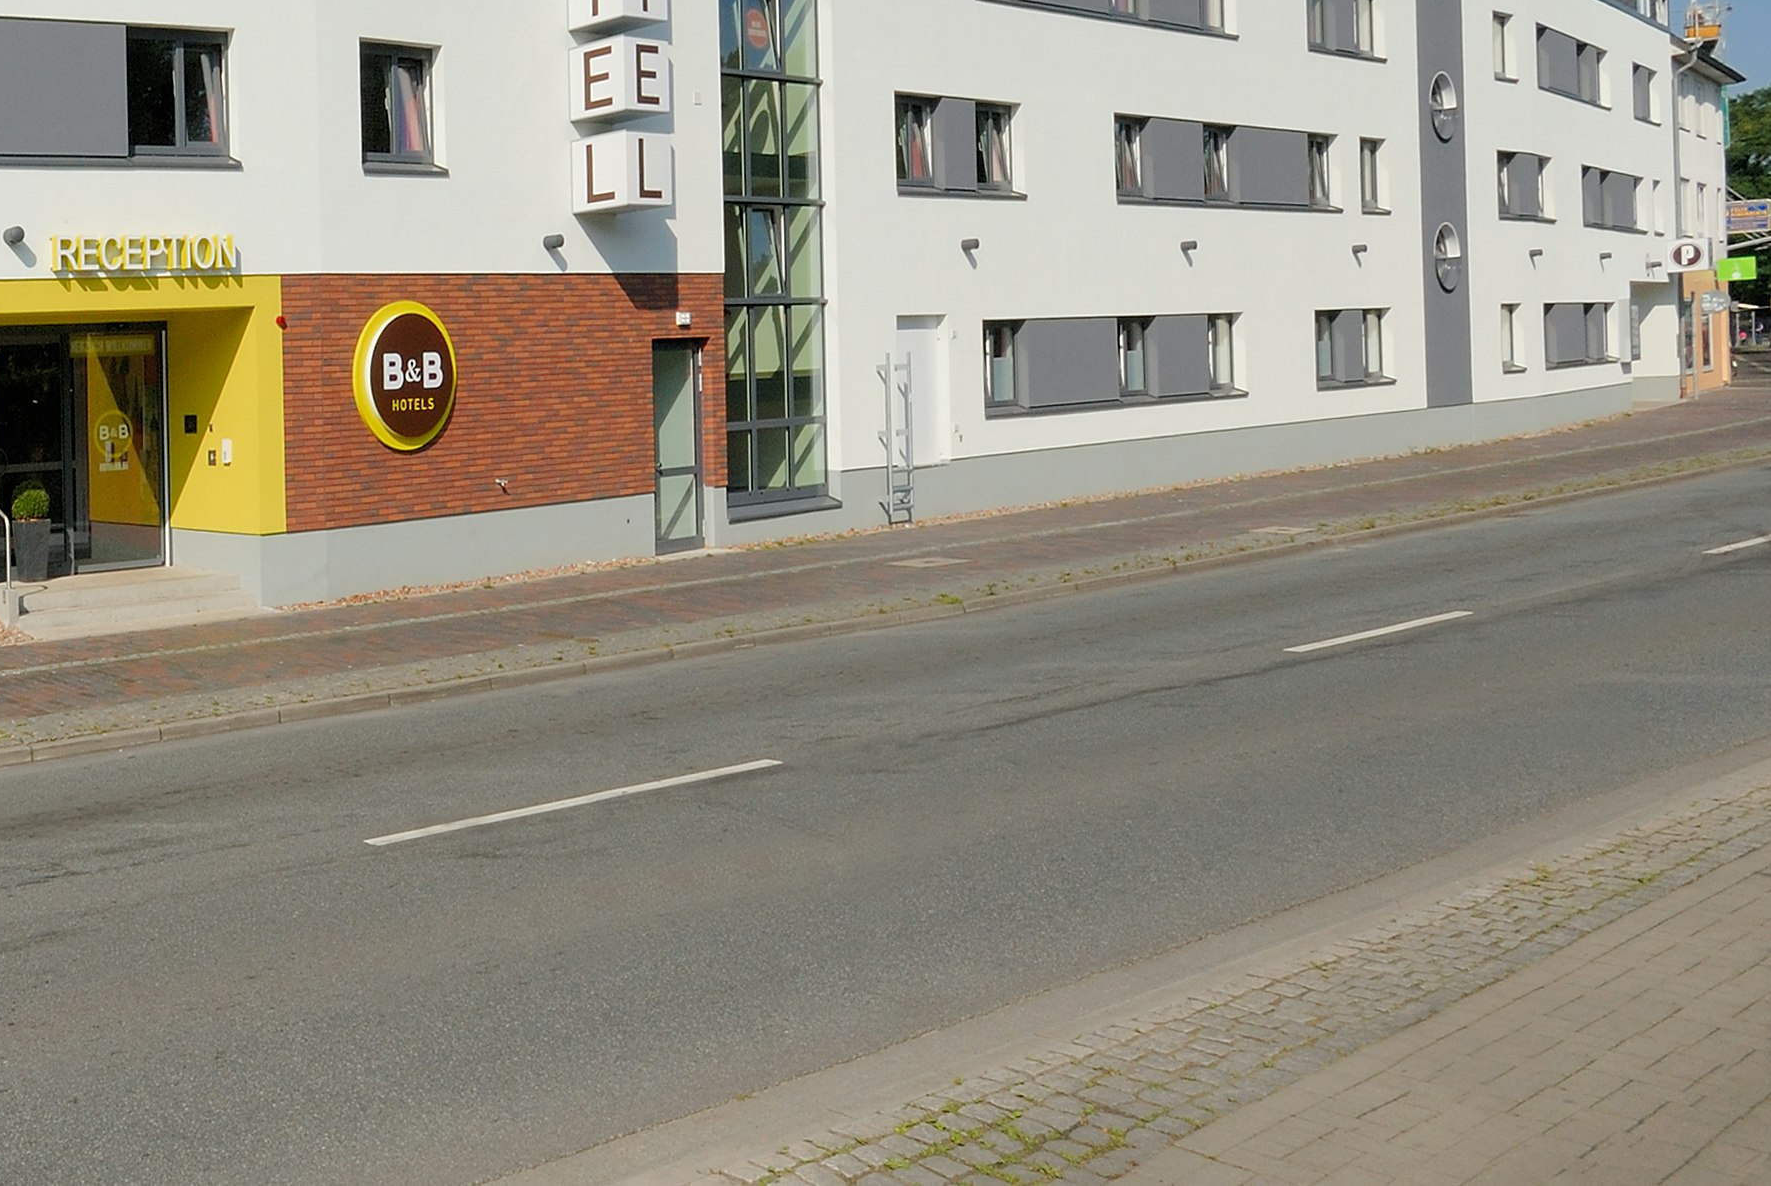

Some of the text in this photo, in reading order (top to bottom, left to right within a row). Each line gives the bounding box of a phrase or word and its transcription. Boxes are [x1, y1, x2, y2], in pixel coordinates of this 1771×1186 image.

[51, 234, 237, 271] RECEPTION
[383, 352, 444, 390] B&B
[392, 397, 435, 412] HOTELS
[99, 424, 129, 441] B&B
